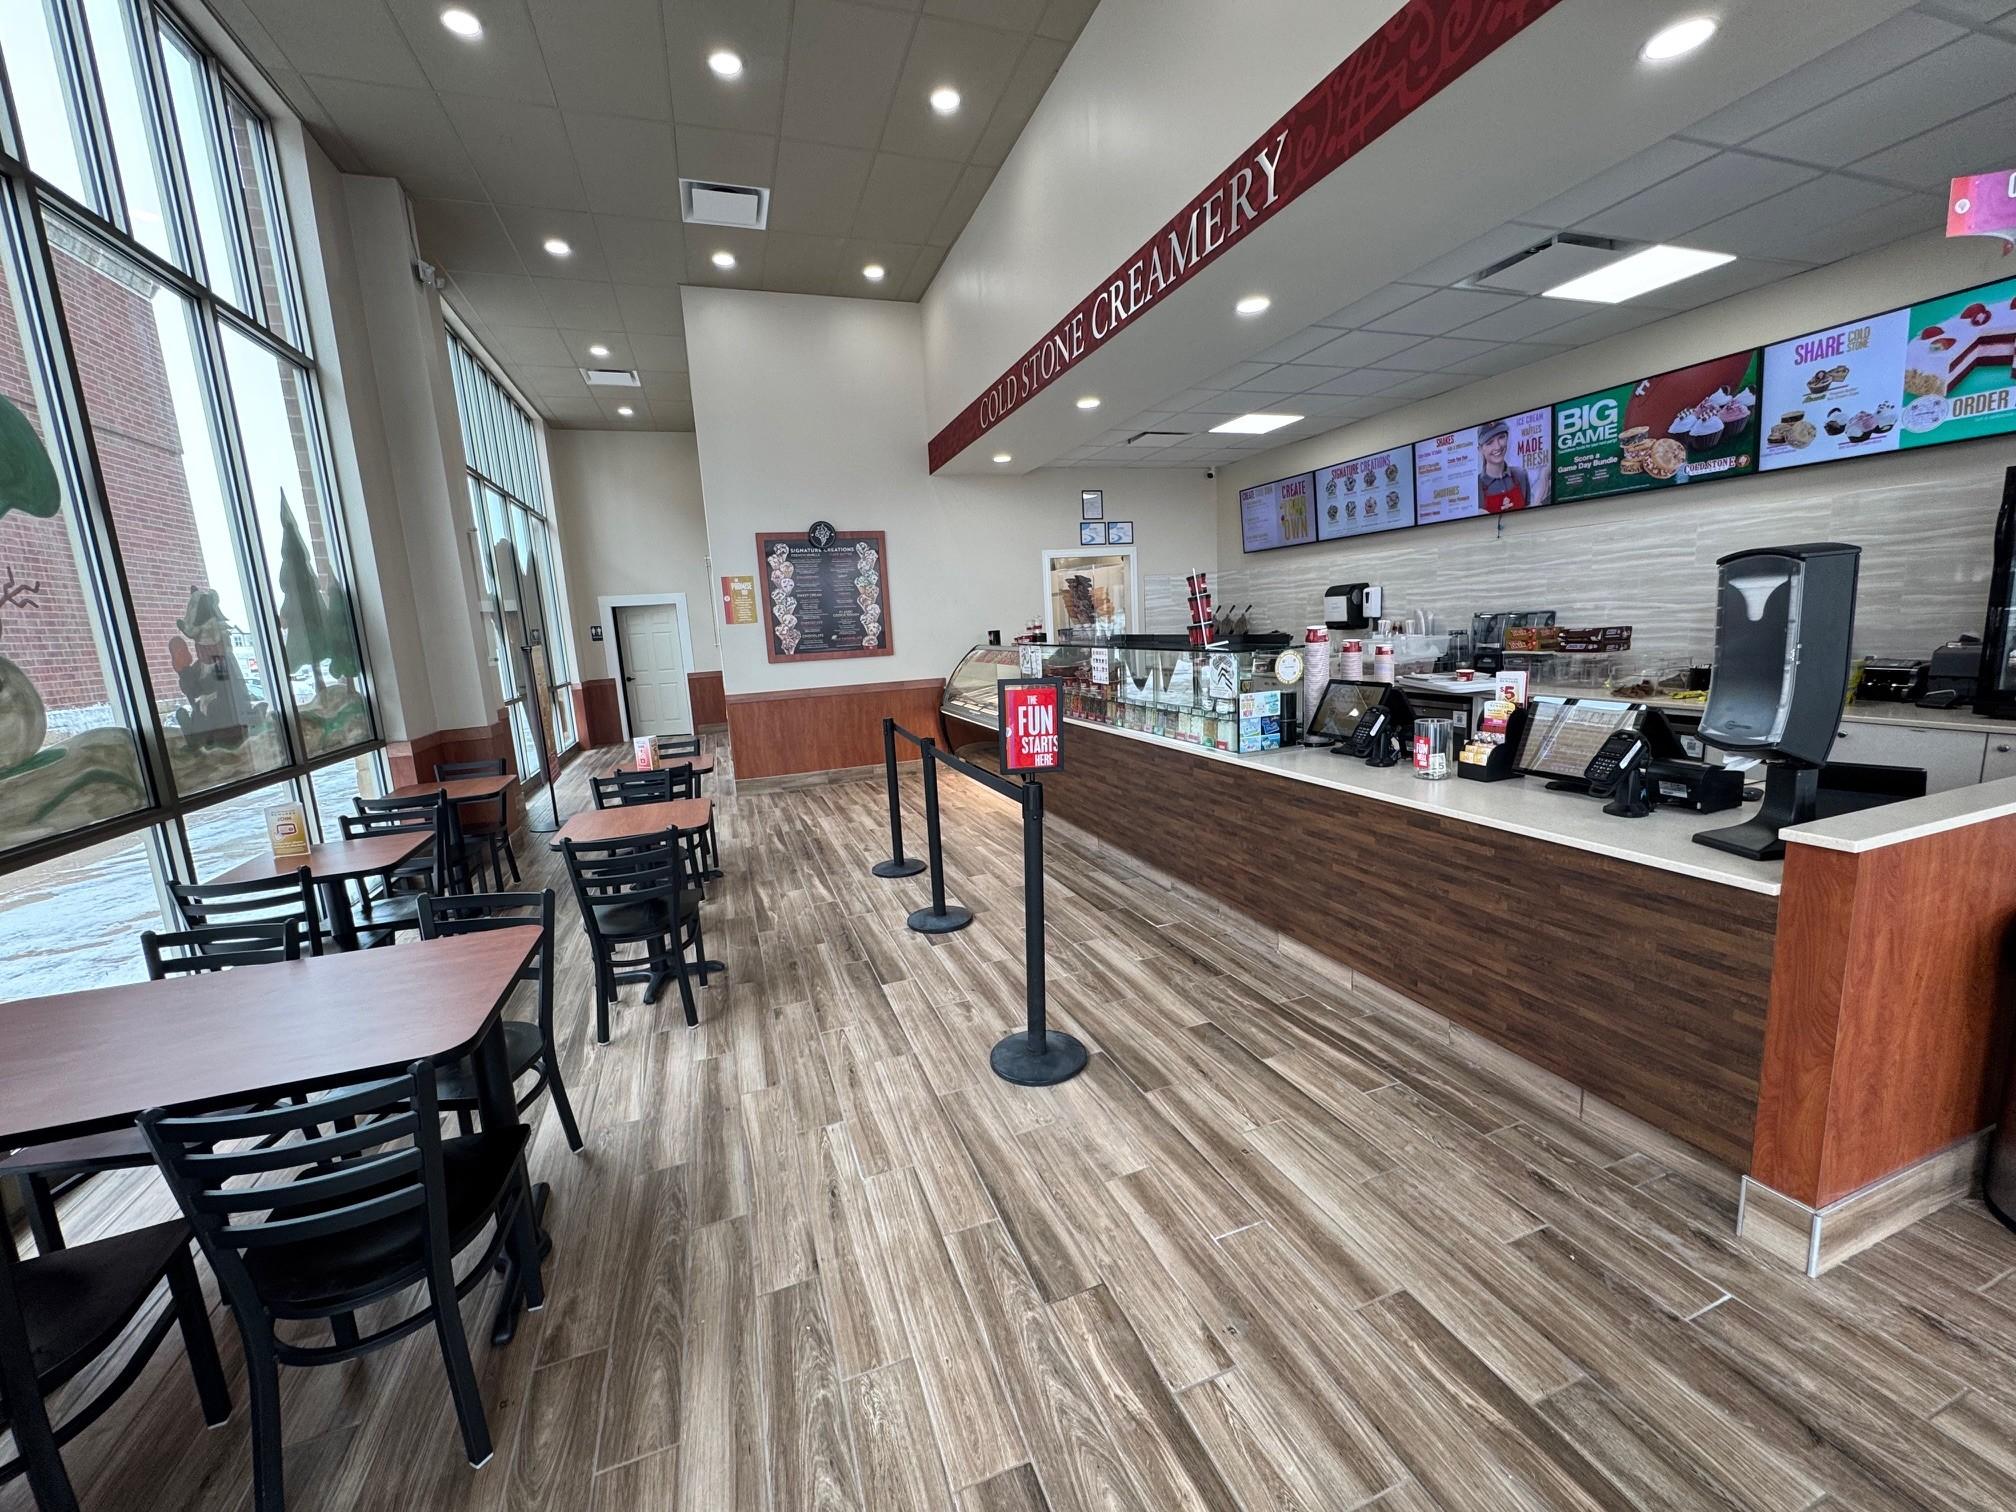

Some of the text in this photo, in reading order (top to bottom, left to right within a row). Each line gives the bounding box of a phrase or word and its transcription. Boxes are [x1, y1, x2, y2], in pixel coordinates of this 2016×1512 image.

[979, 130, 1288, 429] COLD STONE CREAMERY
[1848, 326, 1871, 342] COLD
[1794, 333, 1846, 366] SHARE
[1847, 340, 1869, 353] STONE
[1952, 389, 2010, 418] ORDER
[1557, 398, 1618, 436] BIG
[1557, 423, 1618, 450] GAME
[1517, 436, 1543, 457] MADE
[1331, 454, 1391, 480] SIGNATURE CREATIONS
[1522, 449, 1549, 468] FRESH
[1557, 456, 1618, 474] Game Day Bundle
[1573, 454, 1594, 463] Score
[1281, 480, 1306, 499] CREATE
[1026, 695, 1038, 705] THE
[1499, 685, 1515, 700] $5
[1017, 704, 1054, 736] FUN
[1021, 735, 1058, 755] STARTS
[1034, 753, 1054, 767] HERE
